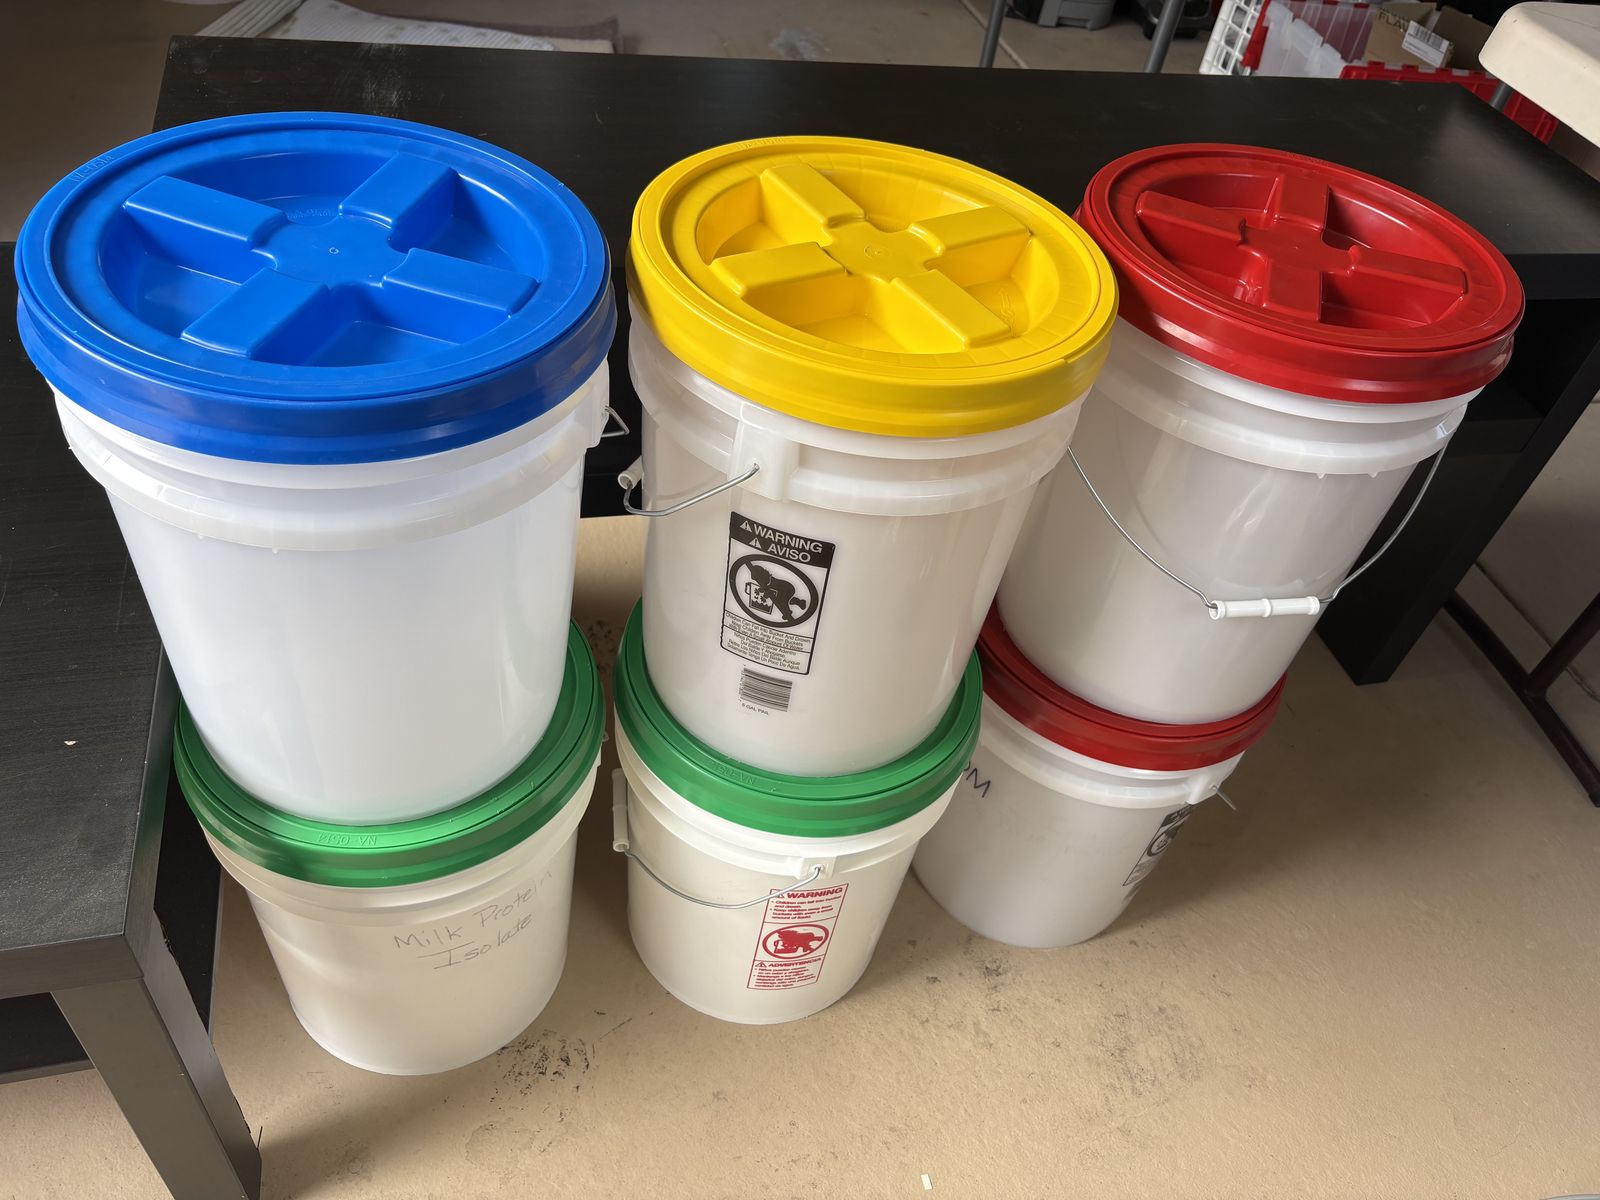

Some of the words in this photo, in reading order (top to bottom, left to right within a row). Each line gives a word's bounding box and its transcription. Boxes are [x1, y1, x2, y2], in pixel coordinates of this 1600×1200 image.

[754, 524, 823, 553] WARNING
[768, 544, 811, 562] AVISO
[787, 888, 843, 898] WARNING
[394, 926, 463, 948] Milk
[472, 872, 552, 927] Protein
[416, 914, 532, 970] Isolate
[768, 958, 822, 967] ADVERTENCIA
